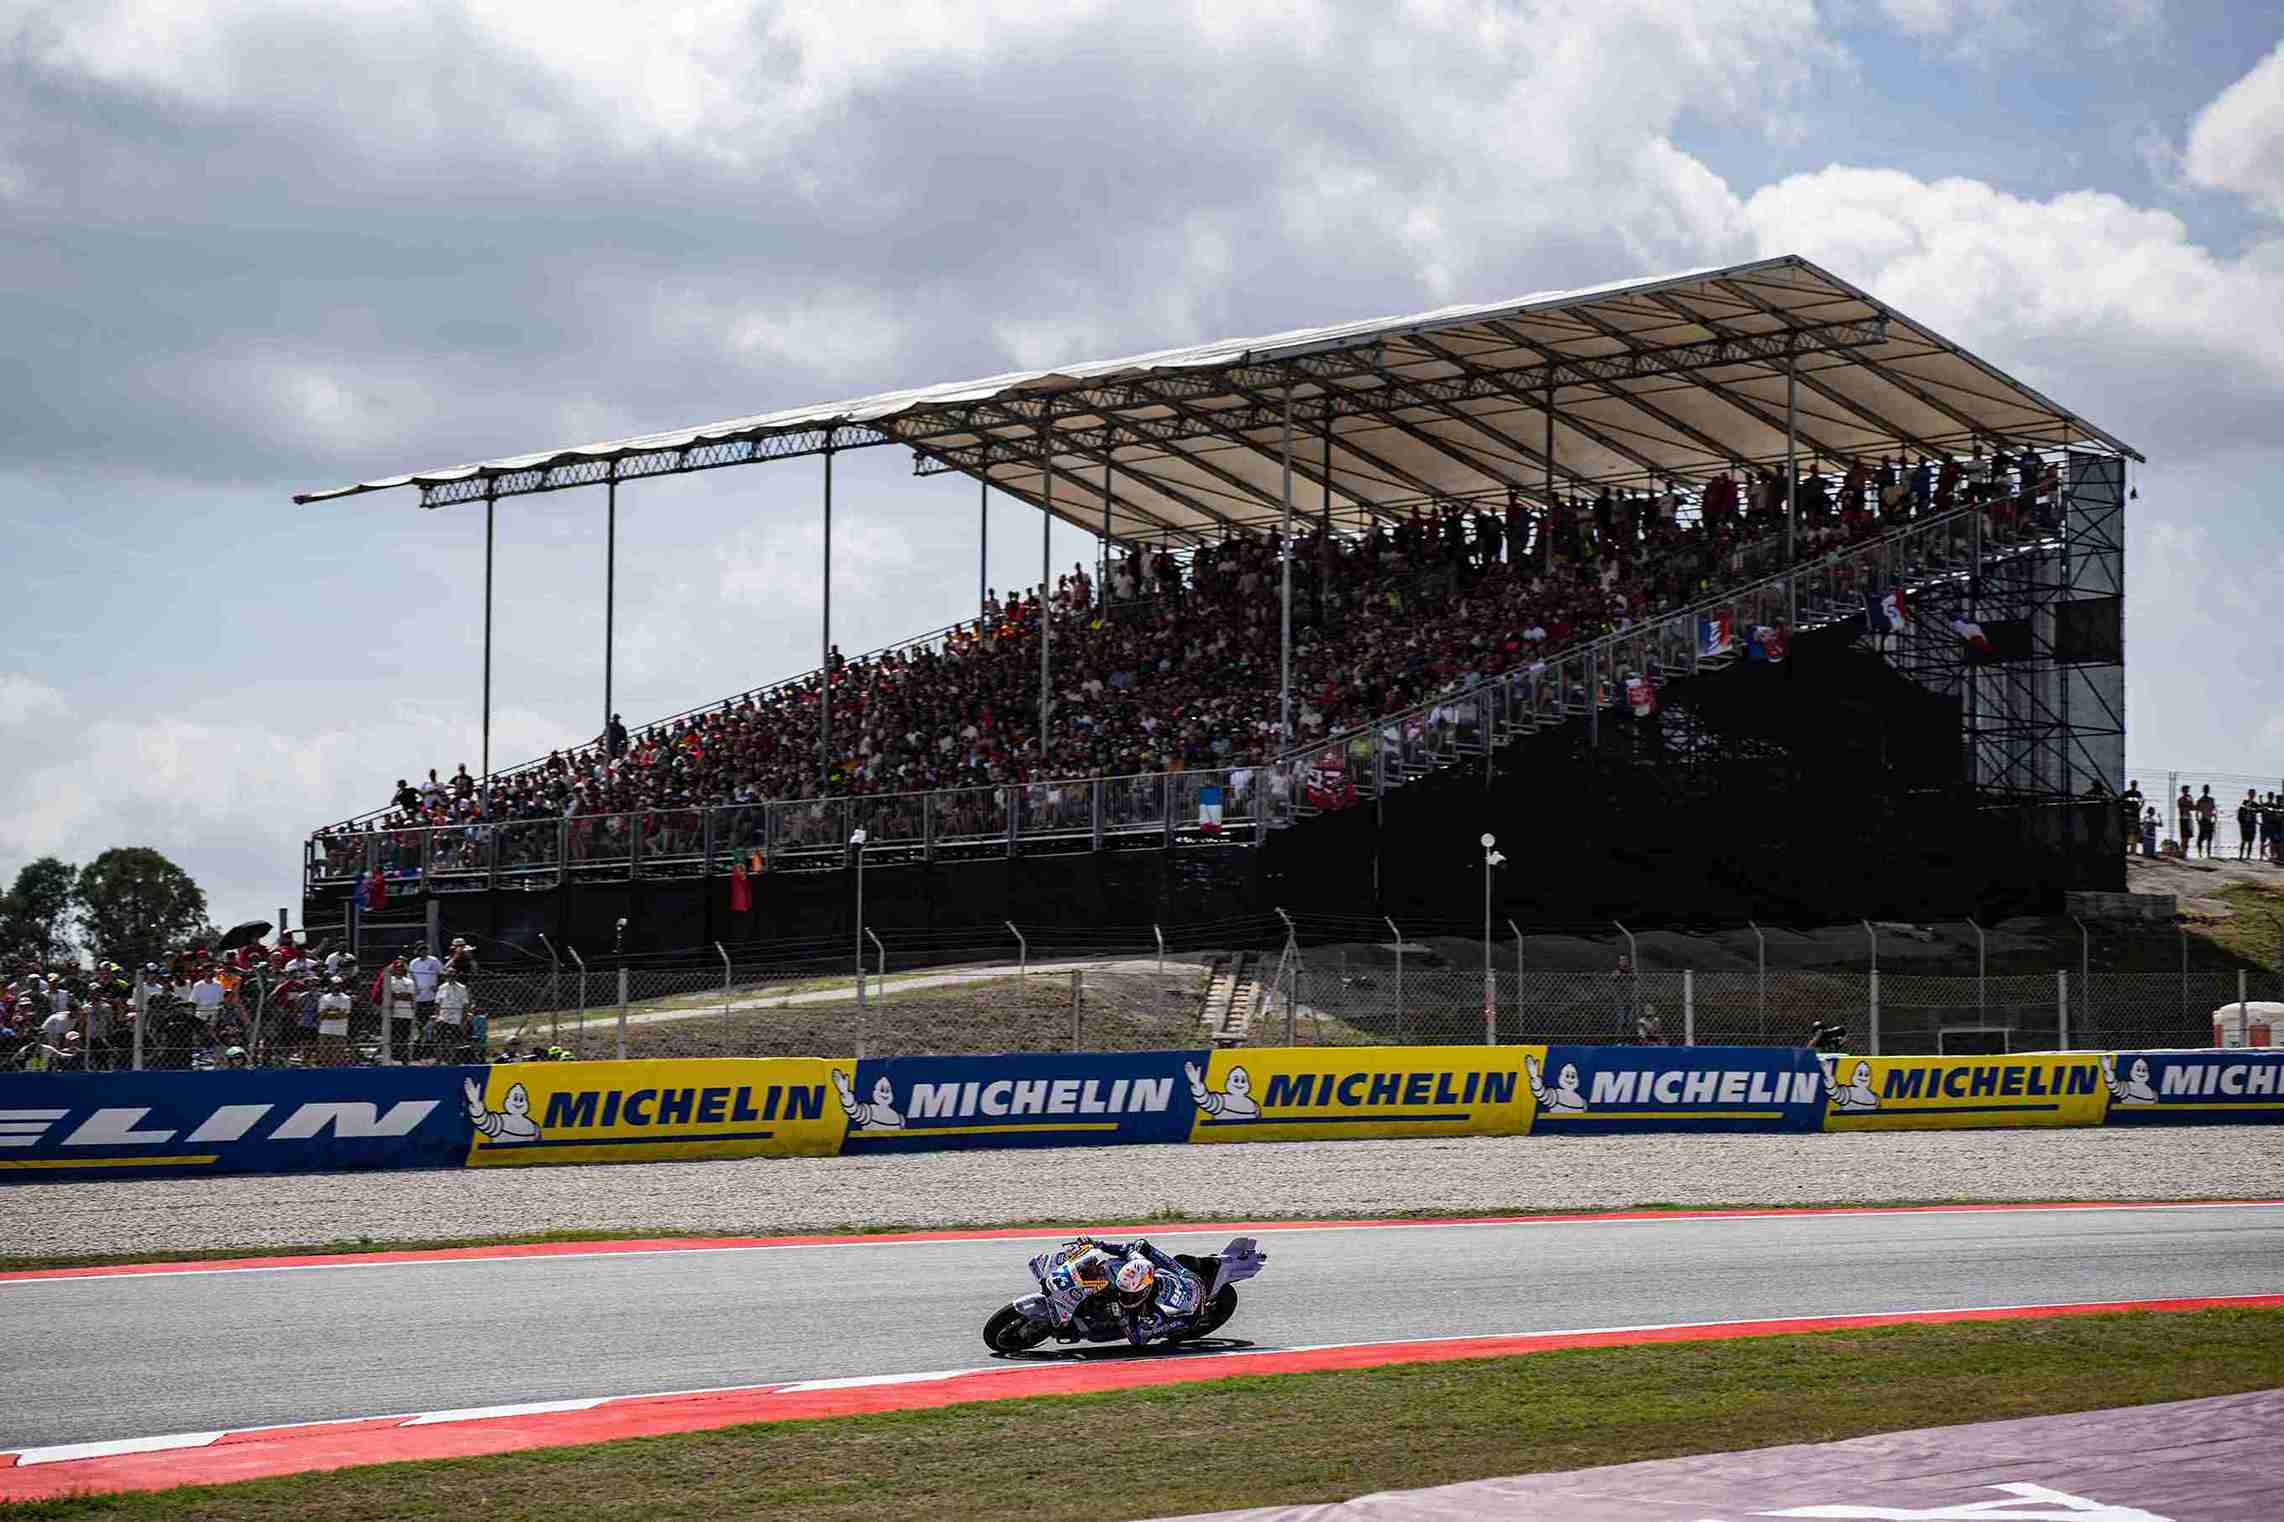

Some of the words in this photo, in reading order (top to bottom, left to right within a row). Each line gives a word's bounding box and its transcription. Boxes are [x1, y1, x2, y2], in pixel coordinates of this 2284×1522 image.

[1264, 1071, 1517, 1107] MICHELIN
[1588, 1071, 1820, 1103] MICHELIN
[1882, 1065, 2101, 1100] MICHELIN
[2160, 1065, 2284, 1095] MICH
[545, 1084, 827, 1129] MICHELIN
[906, 1078, 1175, 1118] MICHELIN
